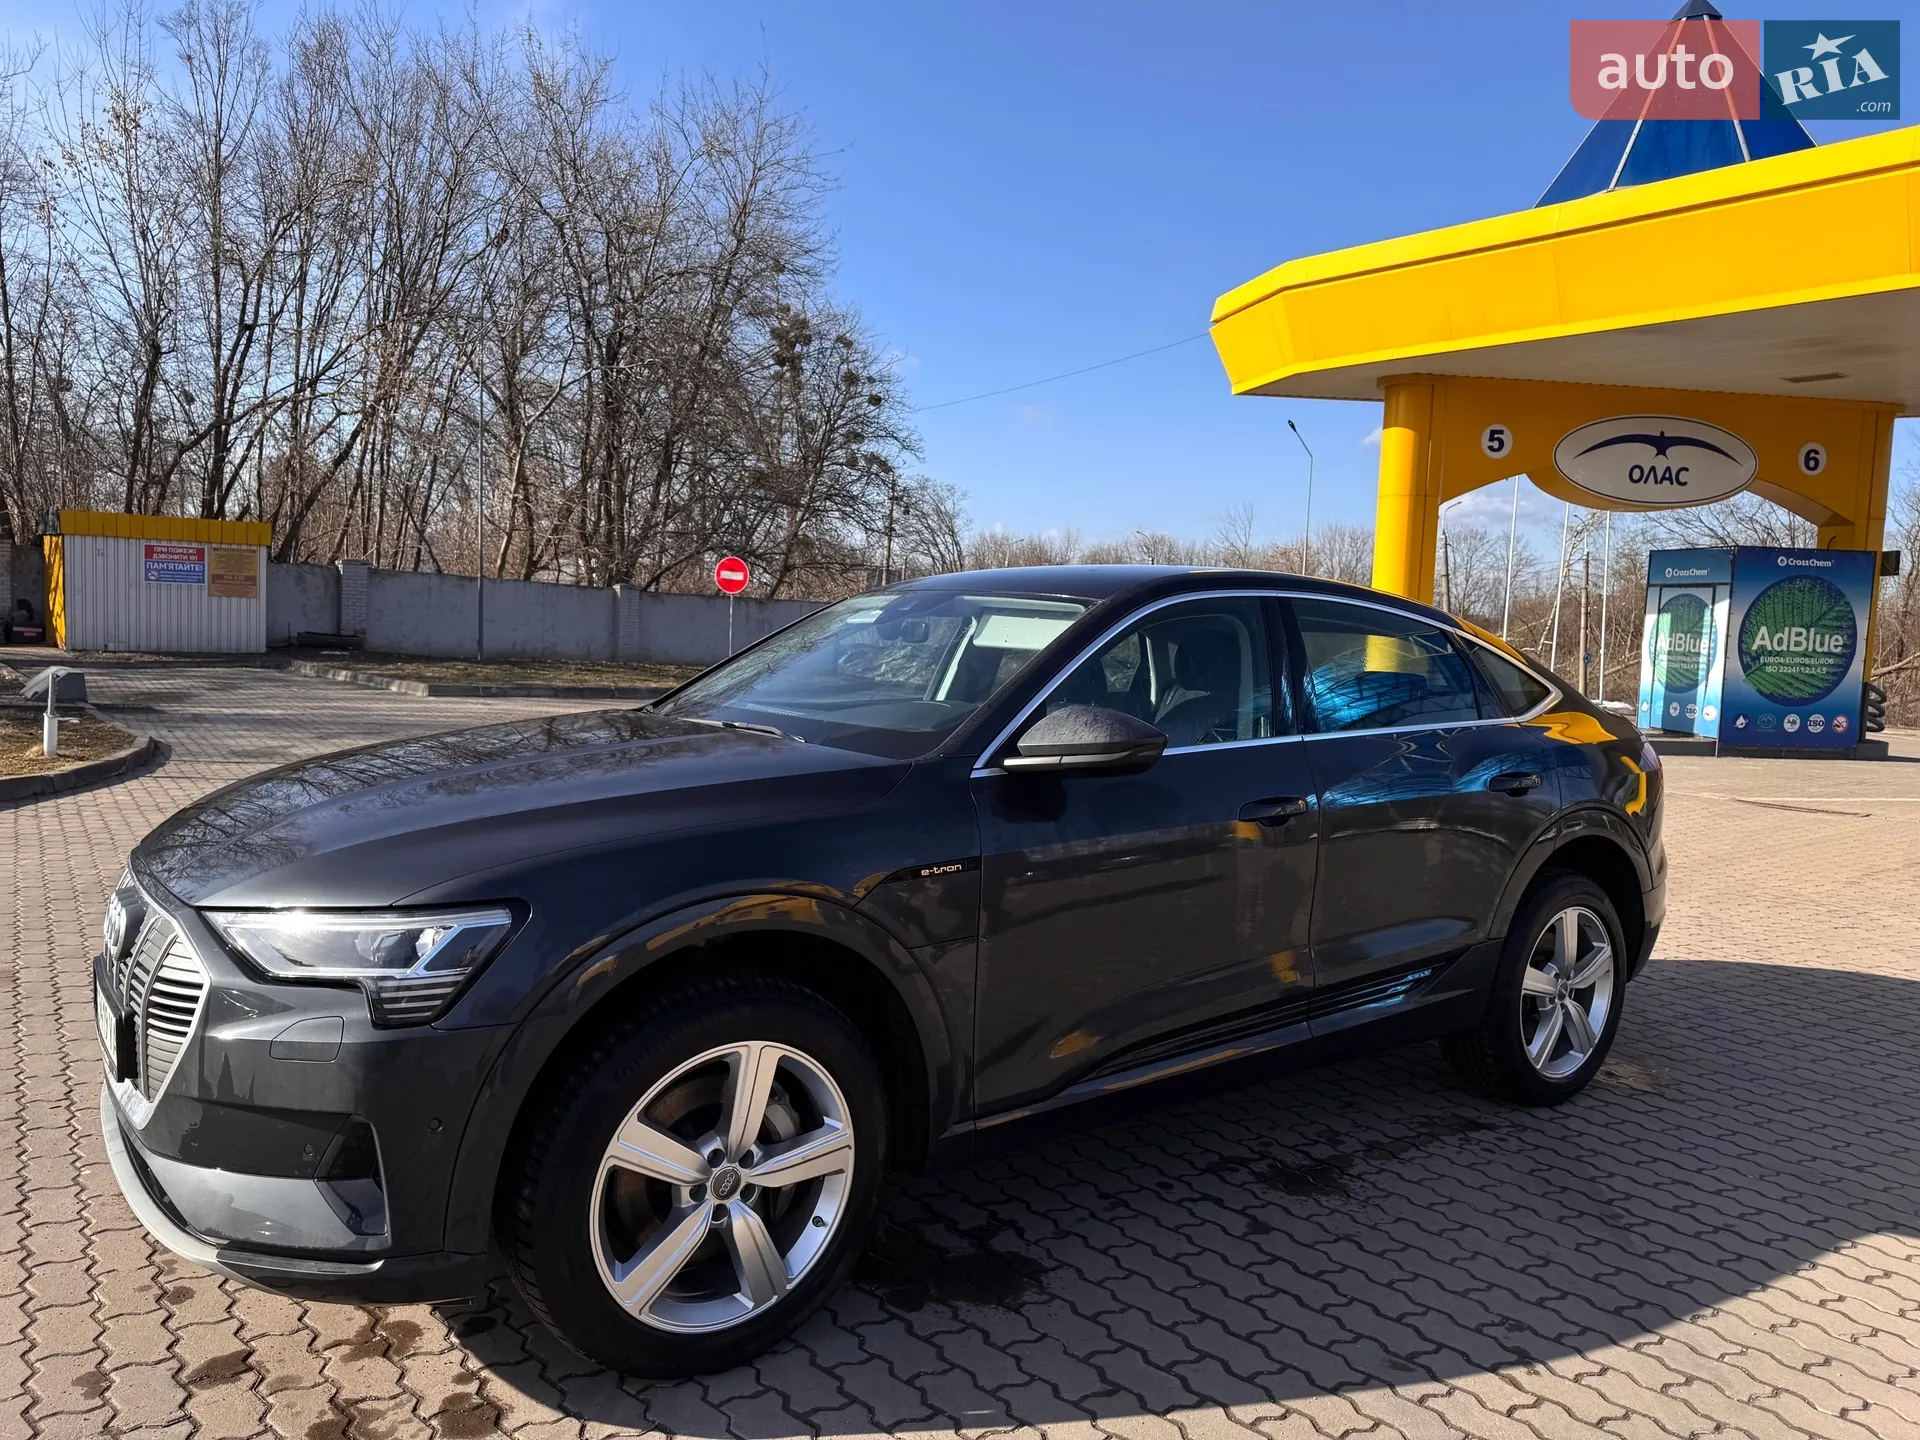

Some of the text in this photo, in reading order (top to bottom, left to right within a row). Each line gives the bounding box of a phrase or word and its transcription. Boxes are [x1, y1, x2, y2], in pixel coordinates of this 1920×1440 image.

[1487, 429, 1505, 452] 5
[1803, 449, 1821, 471] 6
[1628, 464, 1690, 487] ОЛАС
[1673, 568, 1708, 576] CrossChem
[1788, 558, 1832, 567] CrossChem
[1656, 631, 1709, 654] AdBlue
[1751, 626, 1844, 653] AdBlue
[1808, 719, 1825, 727] ISO
[921, 864, 962, 876] e-tron
